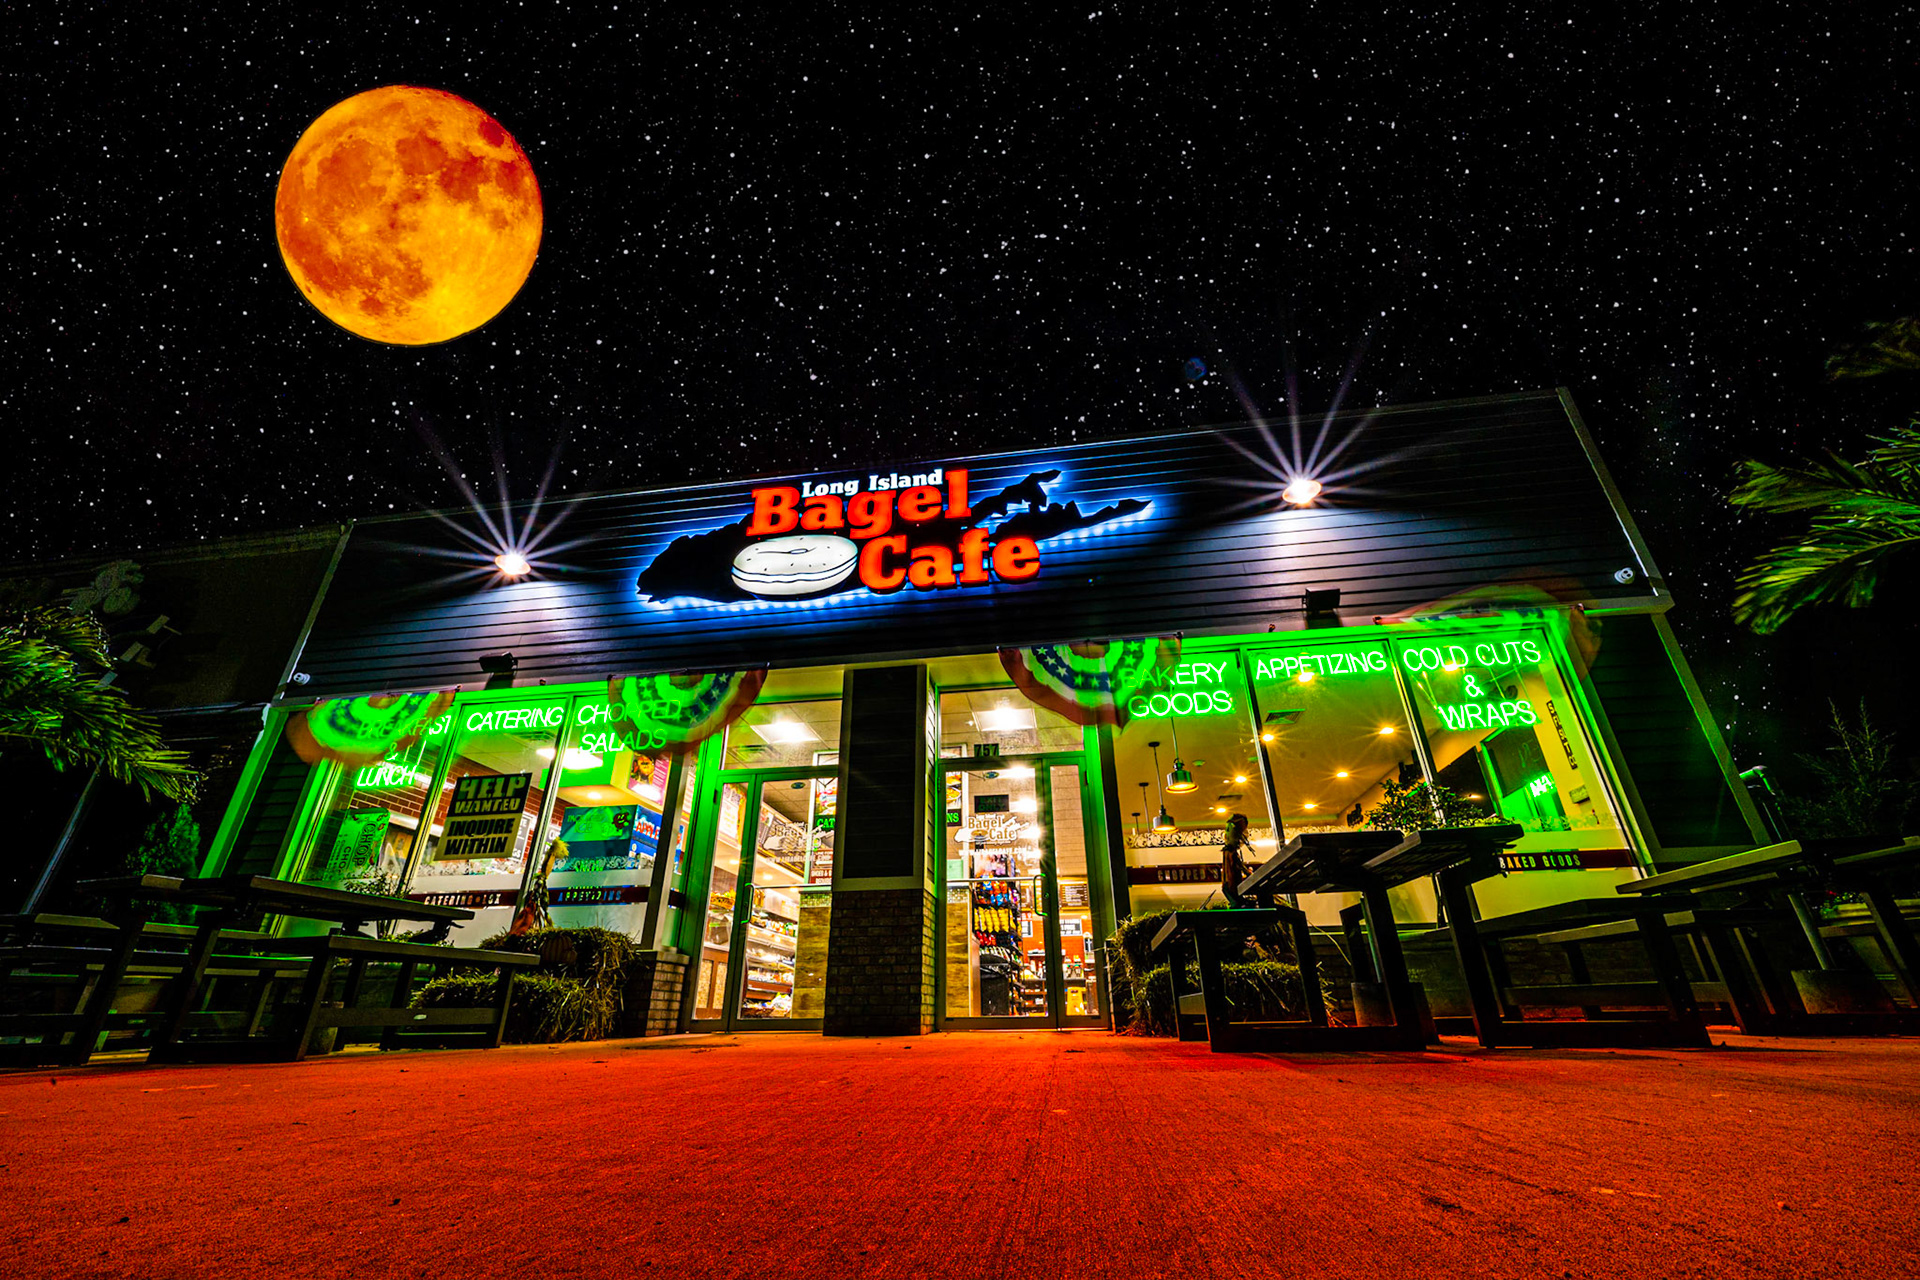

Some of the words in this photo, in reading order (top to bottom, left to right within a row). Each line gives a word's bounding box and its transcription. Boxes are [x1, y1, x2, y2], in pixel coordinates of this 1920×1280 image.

[801, 480, 859, 498] Long
[869, 469, 943, 491] Island
[746, 469, 972, 539] Bagel
[859, 527, 1041, 590] Cafe
[1256, 651, 1387, 680] APPETIZING
[1403, 646, 1469, 672] COLD
[1475, 641, 1541, 666] CUTS
[1120, 661, 1227, 689] BAKERY
[1464, 674, 1485, 697] &
[577, 699, 682, 724] CHOPPED
[1128, 690, 1232, 717] GOODS
[1438, 700, 1536, 730] WRAPS
[466, 706, 565, 731] CATERING
[580, 728, 668, 753] SALADS
[975, 744, 998, 757] 757
[357, 765, 417, 786] LUNCH
[457, 776, 526, 800] HELP
[454, 798, 521, 814] WANTED
[447, 818, 515, 837] INQUIRE
[968, 816, 1002, 830] Bagel
[989, 828, 1016, 840] Cafe
[444, 836, 508, 855] WITHIN
[1499, 855, 1536, 869] BAKED
[424, 894, 473, 906] CATERING
